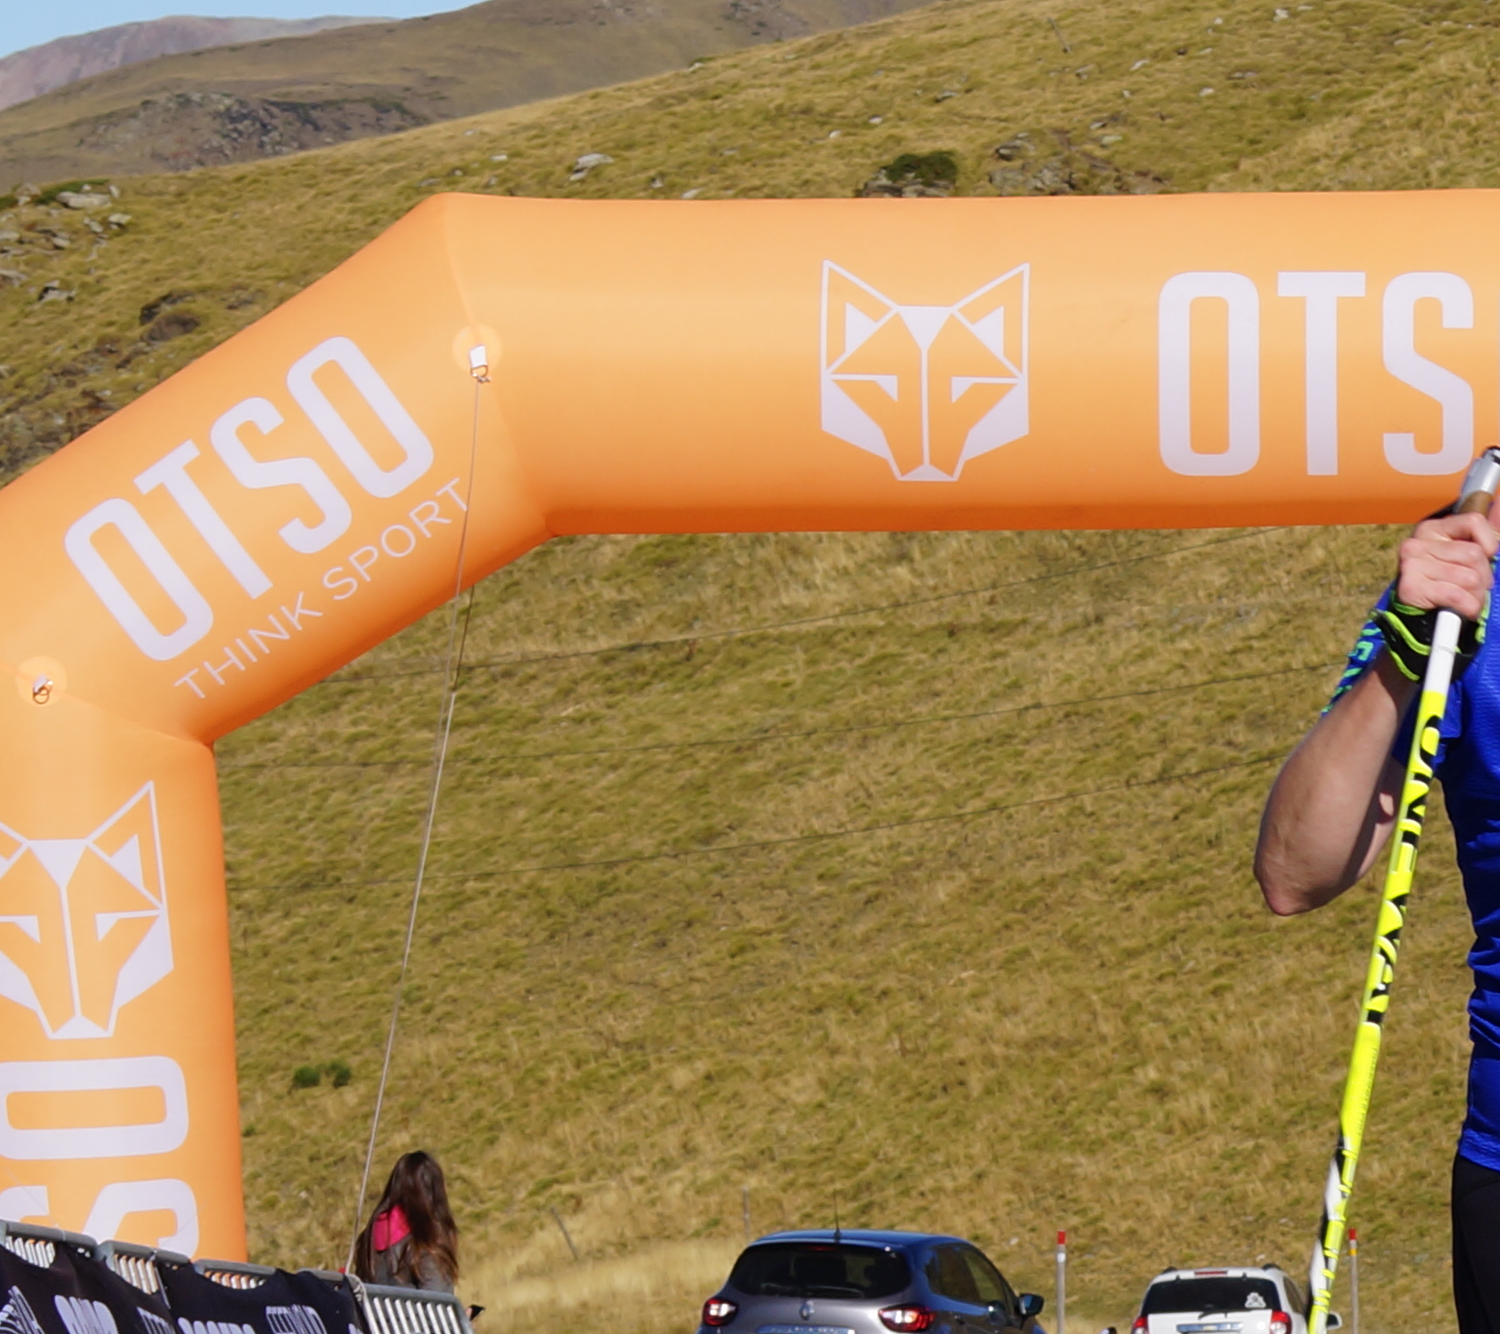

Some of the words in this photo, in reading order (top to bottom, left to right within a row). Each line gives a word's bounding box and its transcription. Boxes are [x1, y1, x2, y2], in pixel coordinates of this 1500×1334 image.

[63, 336, 434, 661] OTSO
[173, 590, 323, 701] THINK
[323, 478, 471, 600] SPORT
